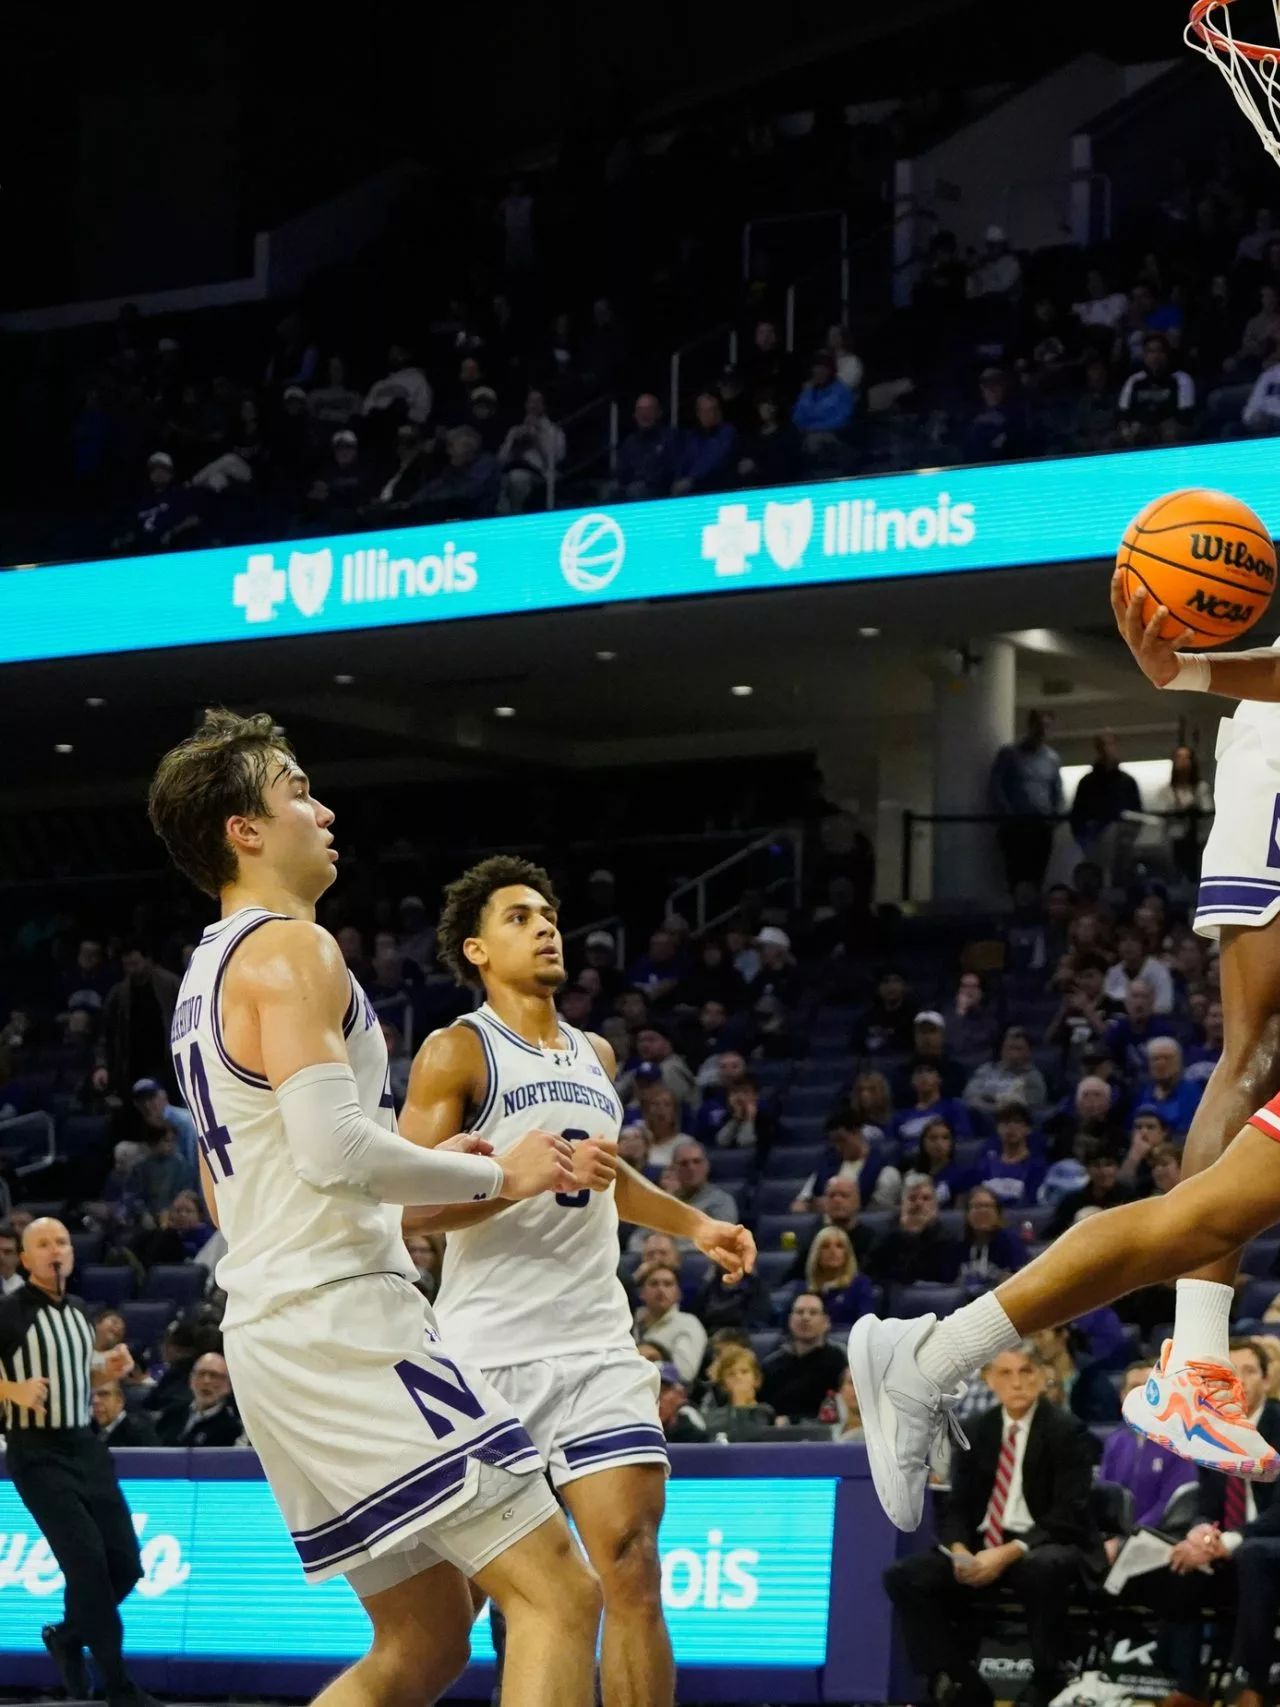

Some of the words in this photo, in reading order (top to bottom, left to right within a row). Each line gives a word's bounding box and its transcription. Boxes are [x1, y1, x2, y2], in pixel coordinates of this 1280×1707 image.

[824, 492, 976, 556] Illinois
[342, 541, 477, 604] Illinois
[503, 1080, 617, 1124] NORTHWESTERN
[393, 1359, 486, 1440] N
